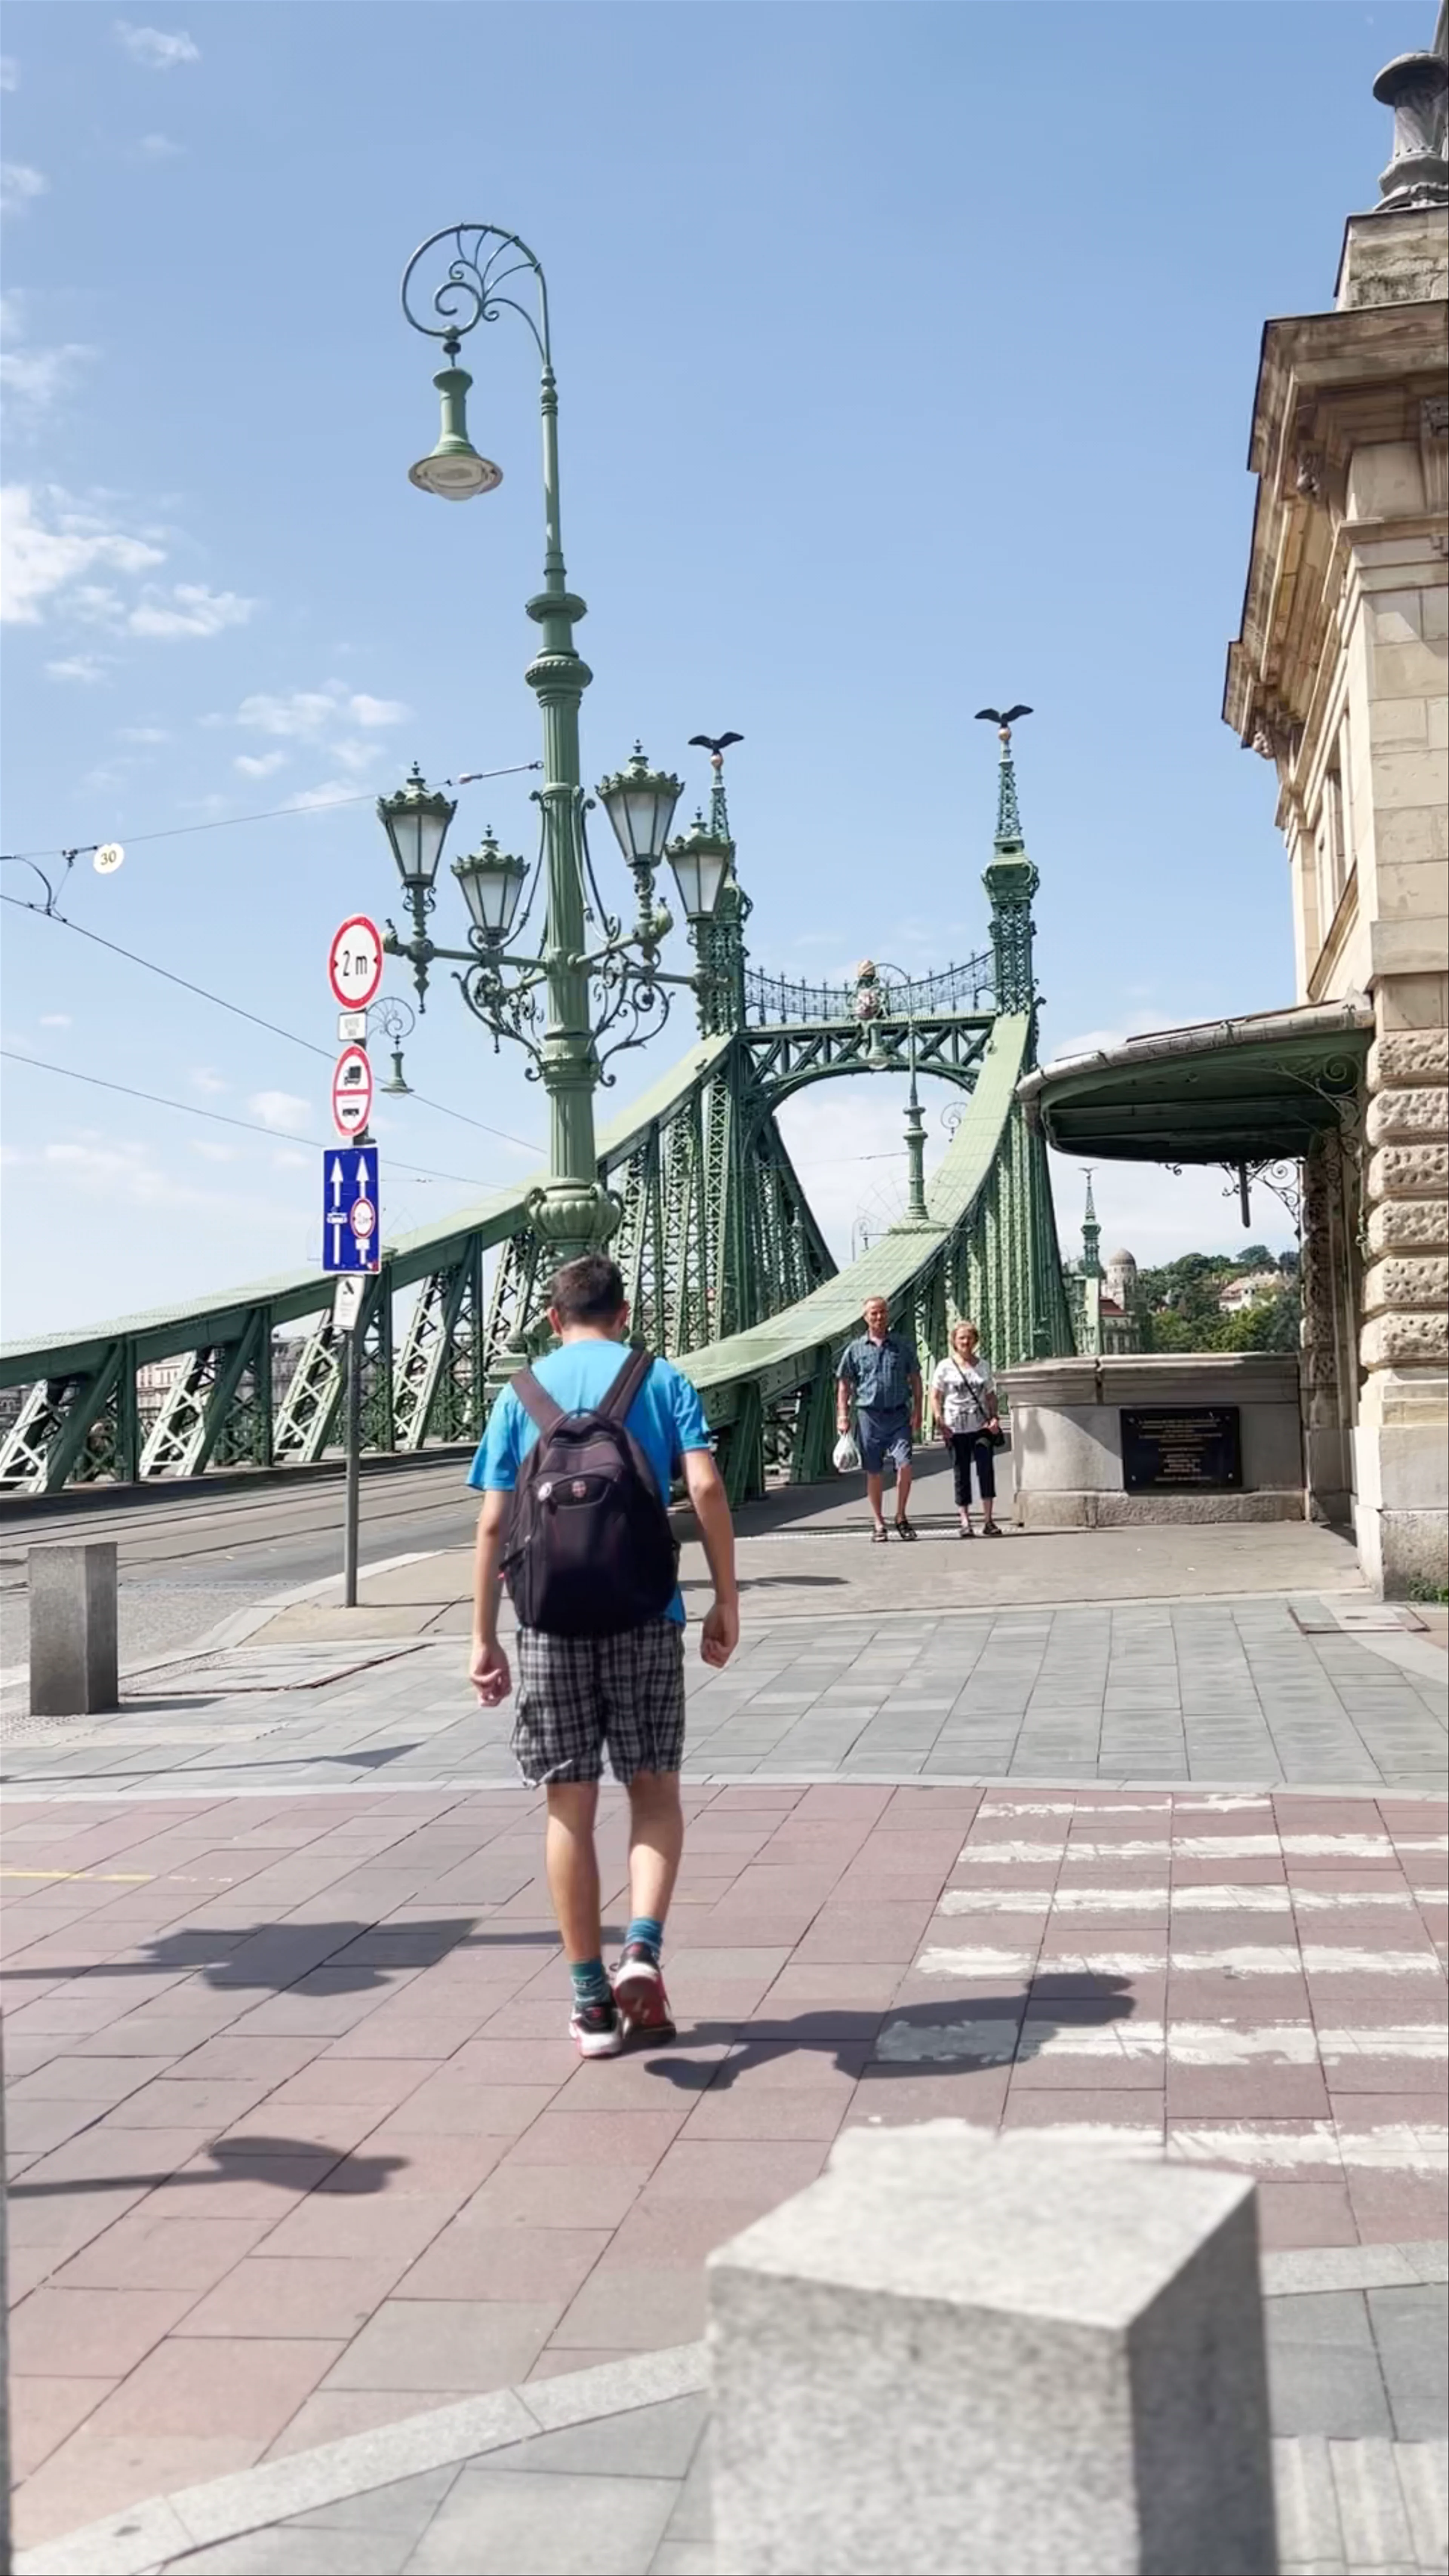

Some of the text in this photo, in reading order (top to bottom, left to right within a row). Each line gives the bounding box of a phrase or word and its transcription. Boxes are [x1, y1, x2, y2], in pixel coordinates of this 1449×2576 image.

[100, 850, 117, 866] 30
[343, 950, 367, 977] 2 m
